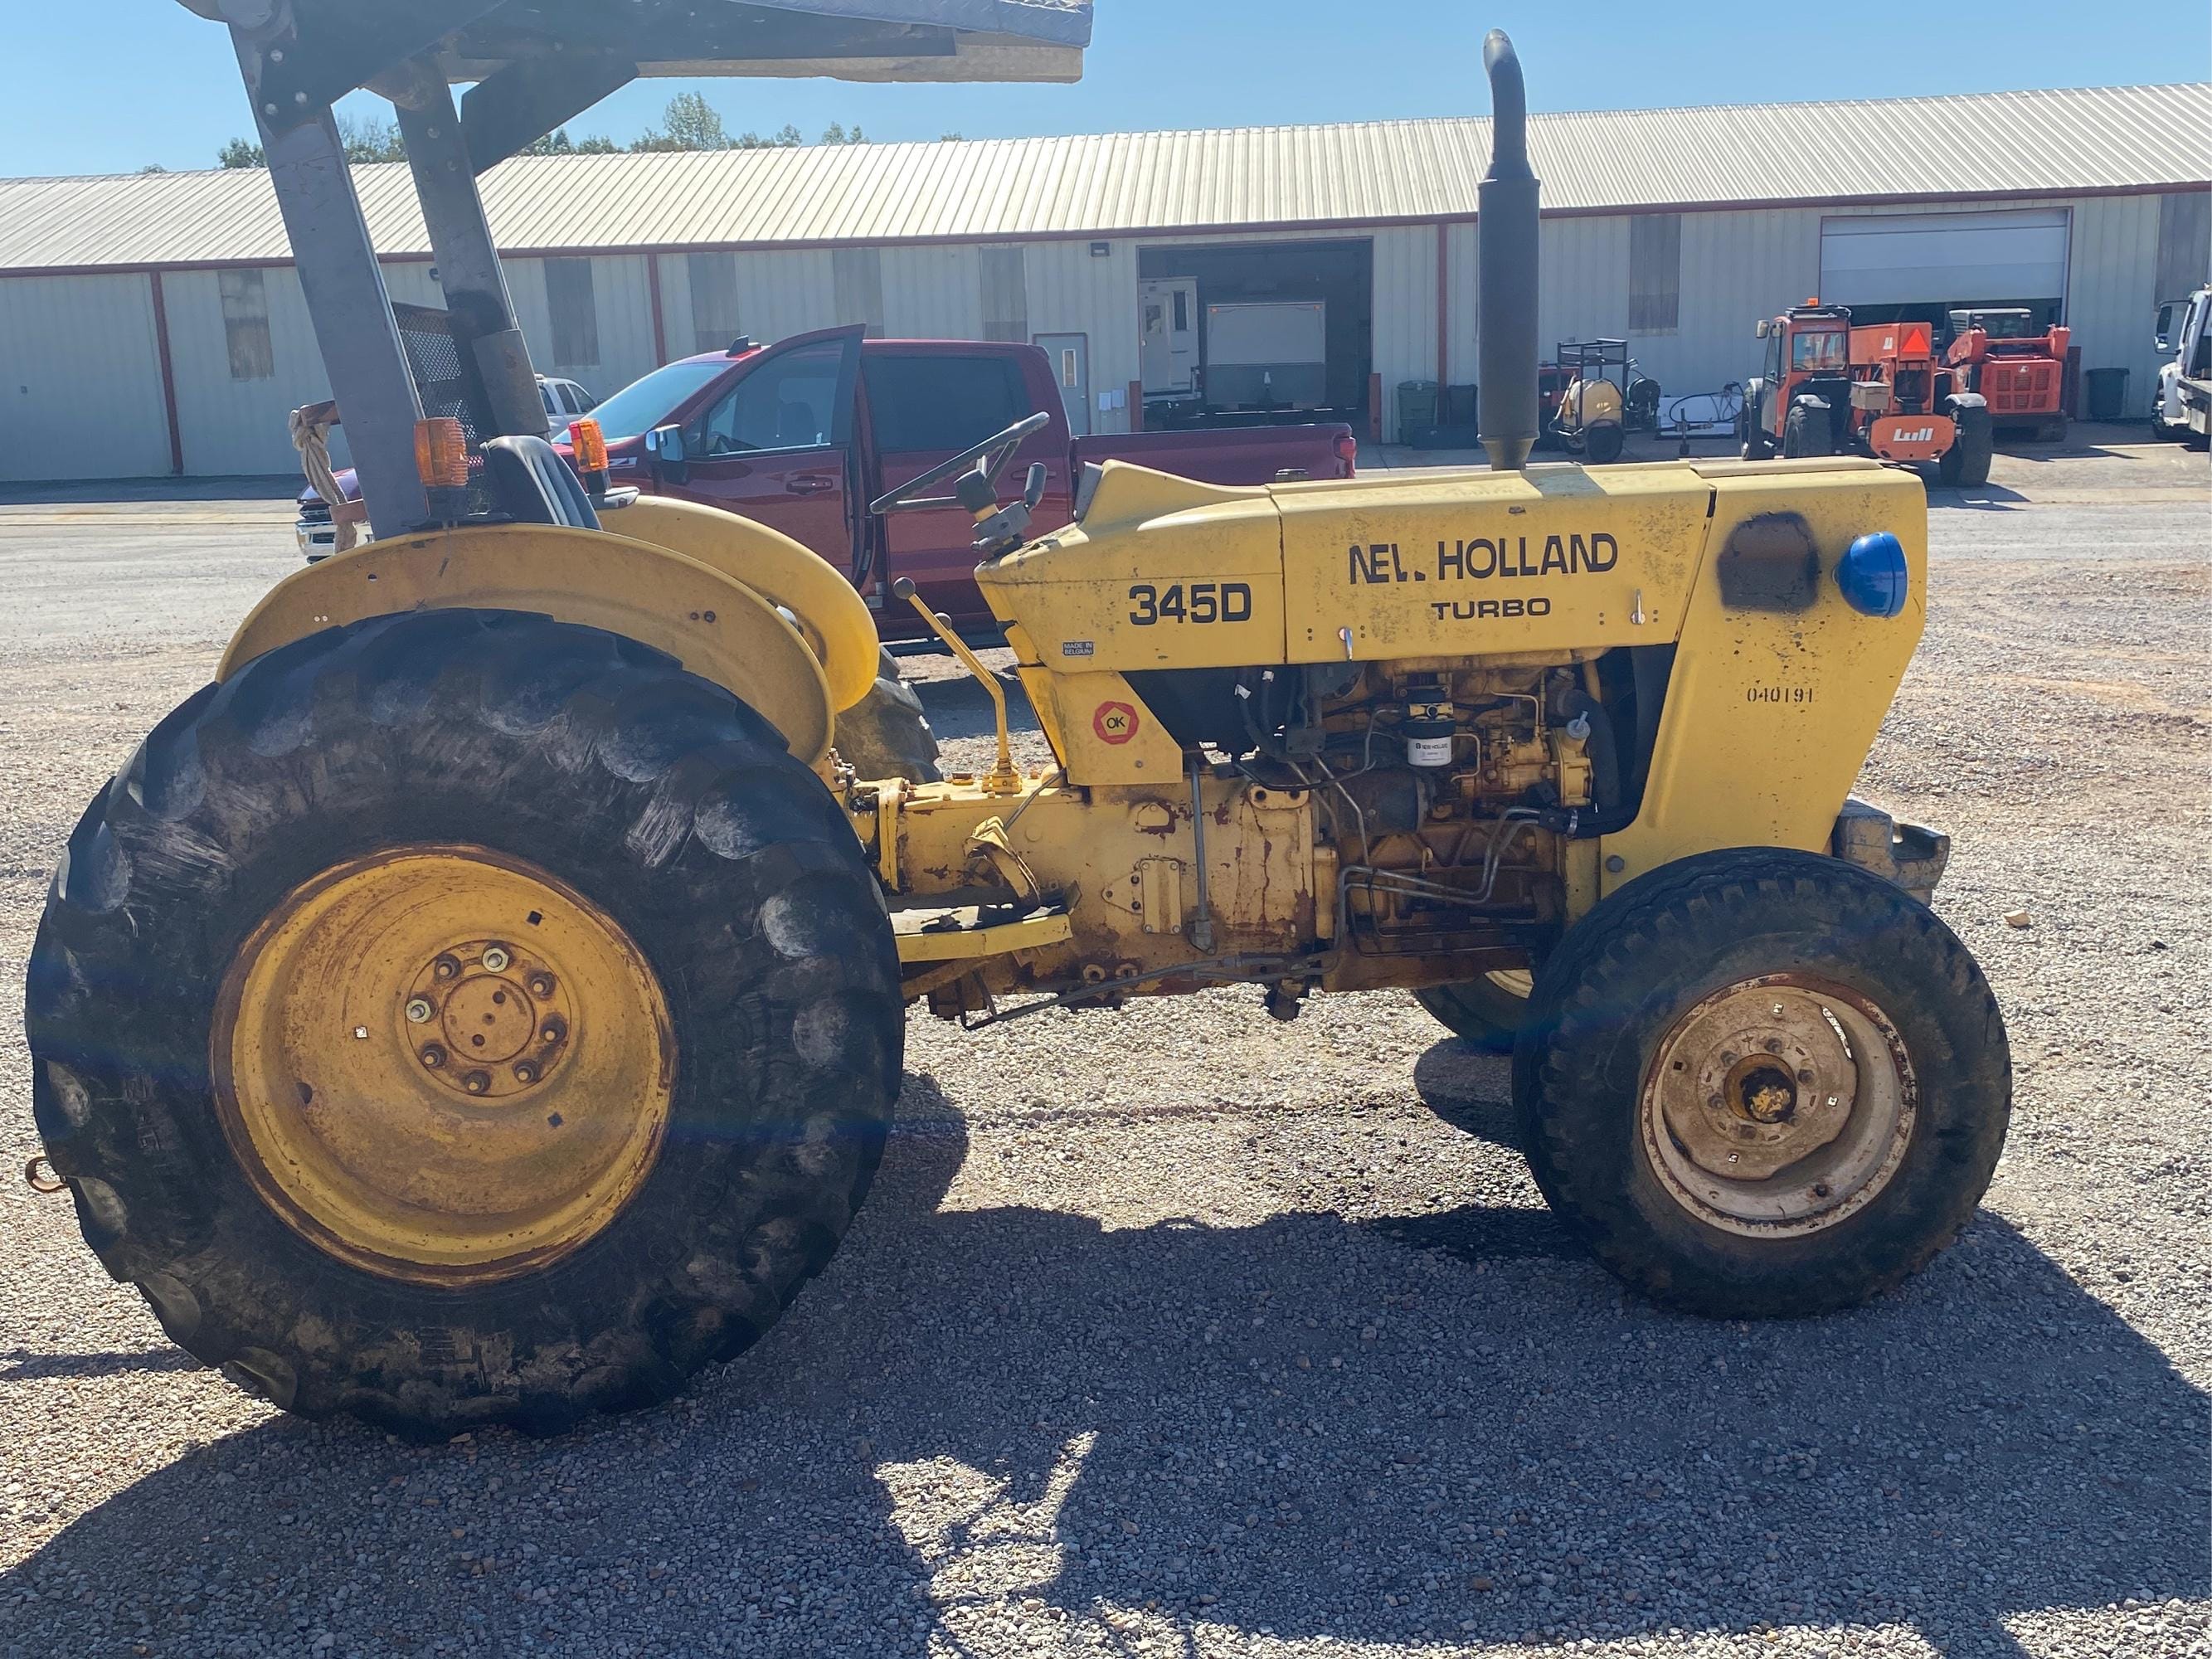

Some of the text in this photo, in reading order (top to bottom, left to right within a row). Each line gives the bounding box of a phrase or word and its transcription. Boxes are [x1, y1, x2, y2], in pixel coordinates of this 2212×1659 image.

[1893, 428, 1934, 442] Lull
[1438, 533, 1617, 580] HOLLAND
[1129, 583, 1252, 625] 345D
[1431, 597, 1551, 620] TURBO
[1747, 688, 1812, 703] 040191
[1106, 716, 1125, 729] OK
